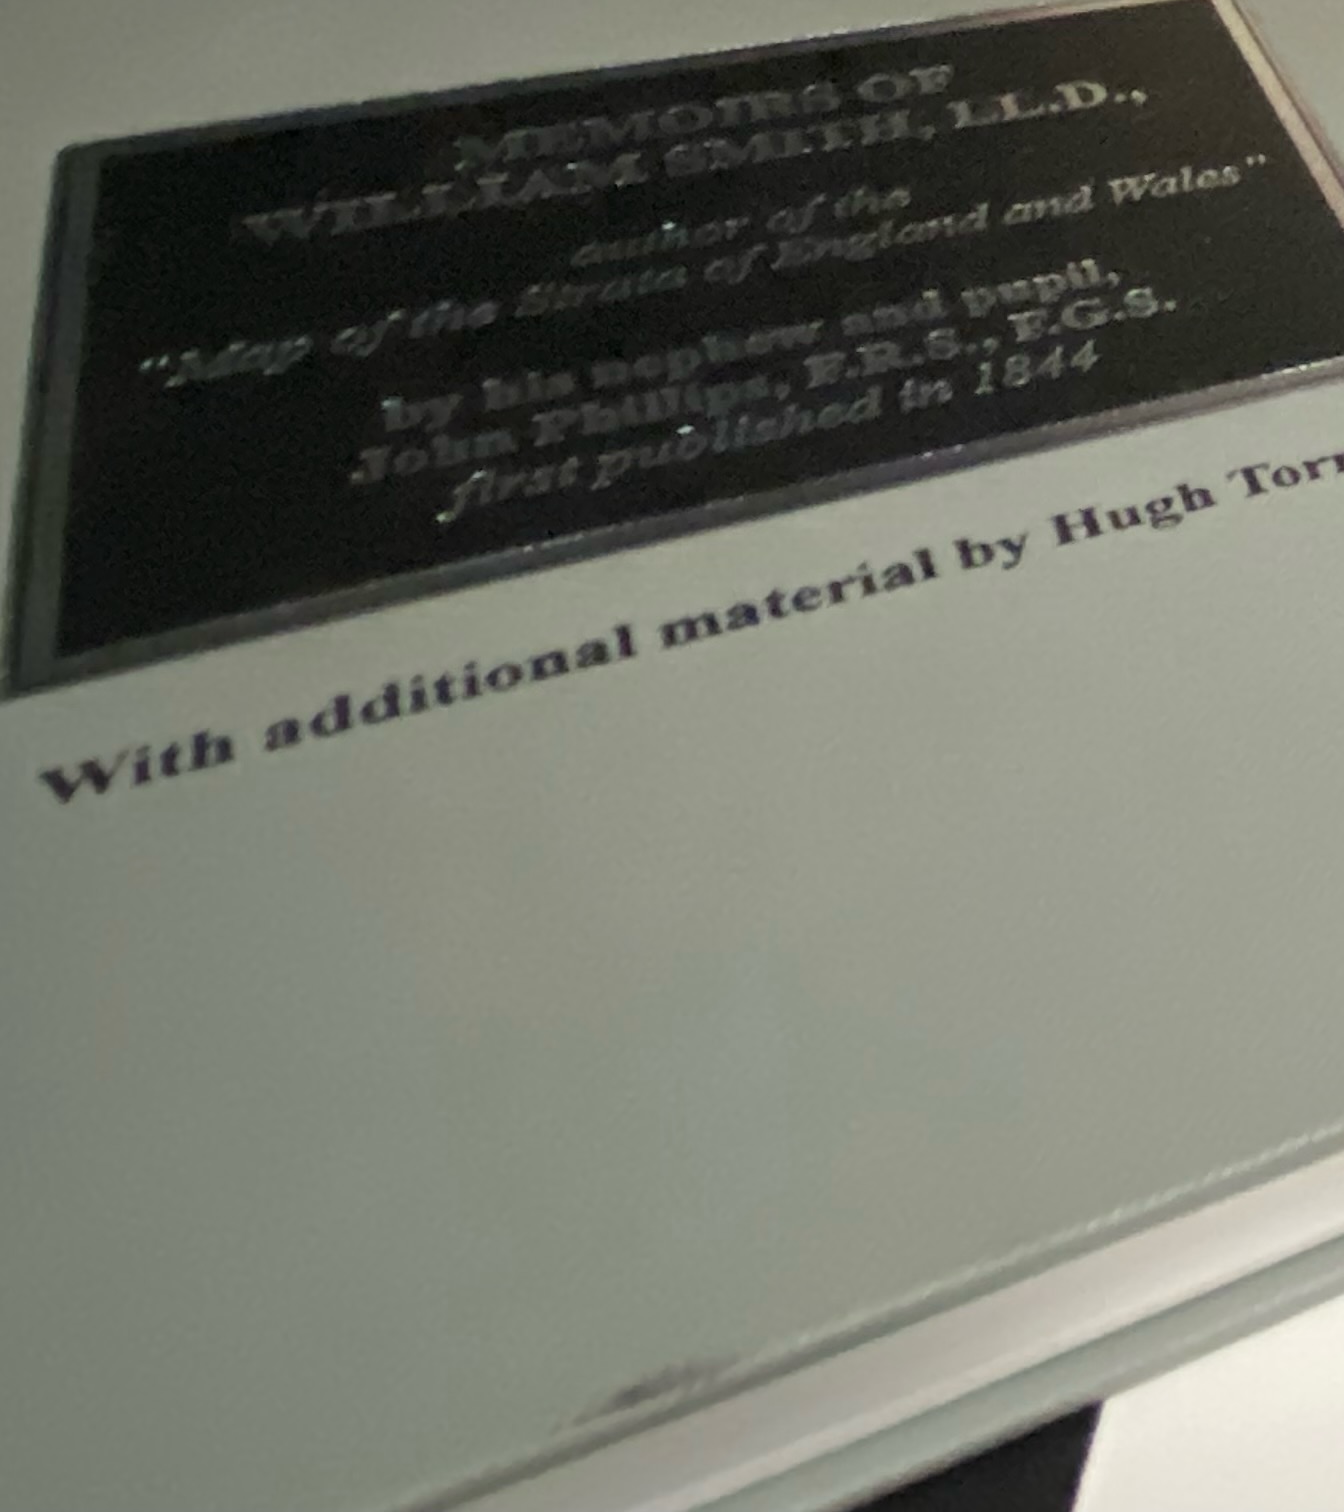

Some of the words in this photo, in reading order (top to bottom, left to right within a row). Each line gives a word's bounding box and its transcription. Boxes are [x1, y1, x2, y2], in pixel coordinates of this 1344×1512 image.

[241, 152, 649, 246] WILLIAM
[663, 108, 936, 177] SMITH,
[453, 82, 842, 173] MEMOIRS
[856, 63, 955, 104] OF
[330, 308, 403, 359] of
[410, 299, 499, 340] the
[702, 242, 770, 286] of
[770, 202, 990, 272] England
[1001, 184, 1094, 226] and
[1106, 152, 1268, 206] Wales"
[766, 193, 827, 236] of
[834, 185, 912, 220] the
[348, 429, 518, 485] John
[1006, 286, 1178, 343] F.G.S.
[381, 393, 466, 433] by
[481, 371, 577, 412] his
[590, 319, 825, 388] nephew
[842, 289, 947, 336] and
[961, 257, 1120, 318] pupil,
[434, 456, 582, 524] first
[589, 388, 884, 491] published
[899, 377, 955, 413] in
[975, 338, 1101, 396] 1844
[38, 728, 235, 806] With
[263, 623, 638, 752] additional
[659, 547, 940, 652] material
[952, 530, 1030, 572] by
[1050, 482, 1218, 548] Hugh
